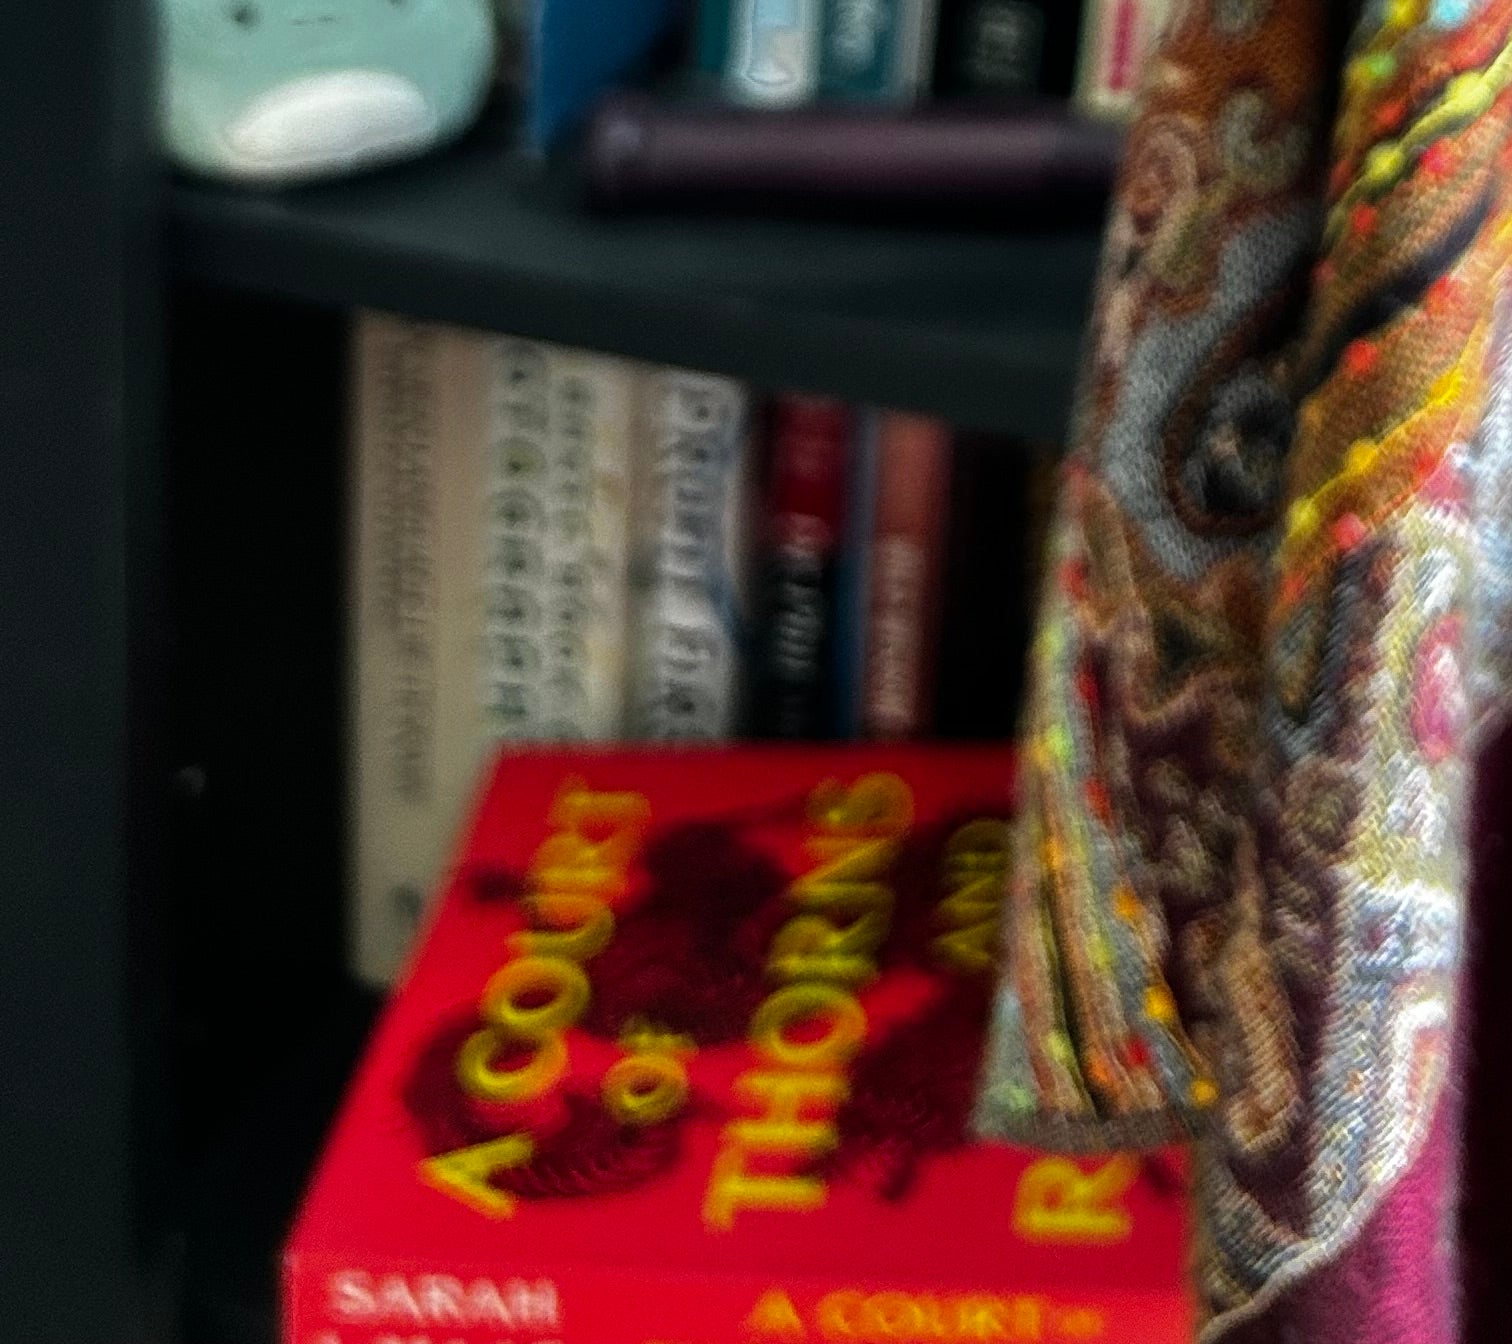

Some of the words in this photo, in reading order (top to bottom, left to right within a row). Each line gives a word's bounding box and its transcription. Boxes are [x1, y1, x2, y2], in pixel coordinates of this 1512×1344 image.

[456, 774, 652, 1104] COURT
[702, 770, 917, 1233] THORNS
[603, 1016, 698, 1125] OF
[417, 1127, 535, 1220] A
[328, 1269, 563, 1330] SARAH
